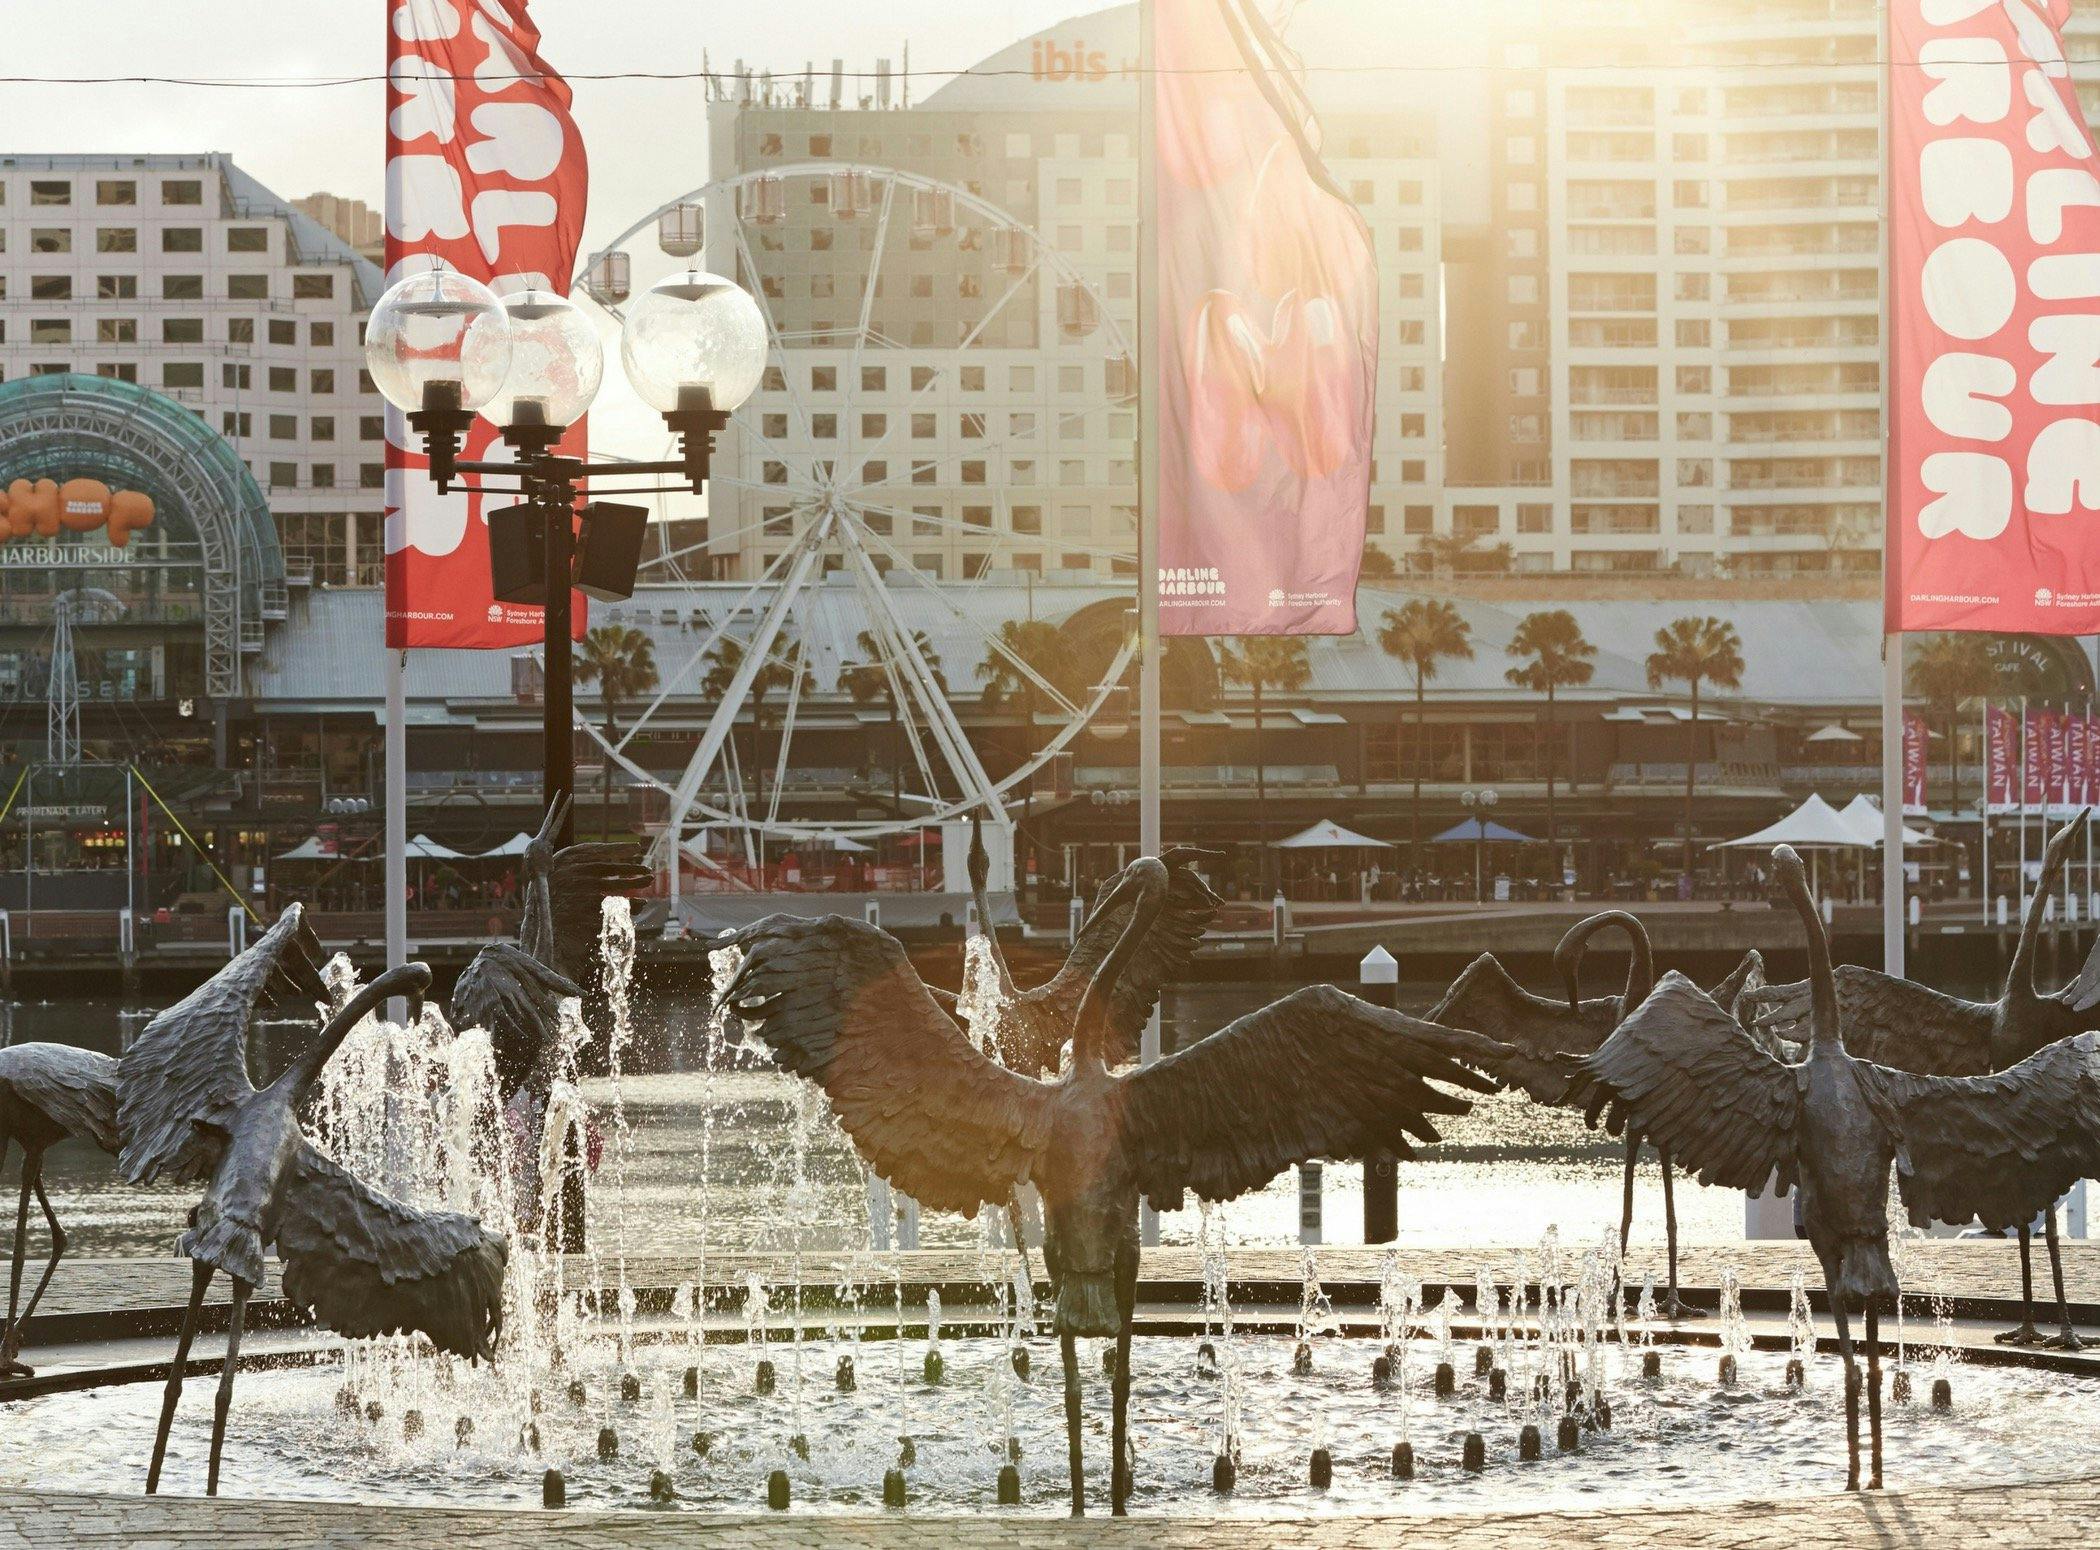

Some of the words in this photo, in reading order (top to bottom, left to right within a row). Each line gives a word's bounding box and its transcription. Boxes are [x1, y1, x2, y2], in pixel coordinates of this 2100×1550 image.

[1032, 40, 1108, 82] ibis
[0, 478, 156, 548] HOP
[1159, 567, 1219, 582] DARLING
[1159, 581, 1226, 595] HARBOUR
[1314, 598, 1341, 607] Authority
[1910, 594, 1999, 604] DARLINGHARBOUR.COM
[2056, 592, 2080, 601] Sydney
[488, 615, 502, 623] NSW
[506, 609, 527, 618] Sydney
[506, 617, 537, 625] Foreshore
[1991, 719, 2006, 787] TAIWAN
[2026, 721, 2039, 787] TAIWAN
[2050, 724, 2064, 787] AIWAN
[2071, 723, 2084, 788] TAIWAN
[75, 805, 108, 815] EATERY
